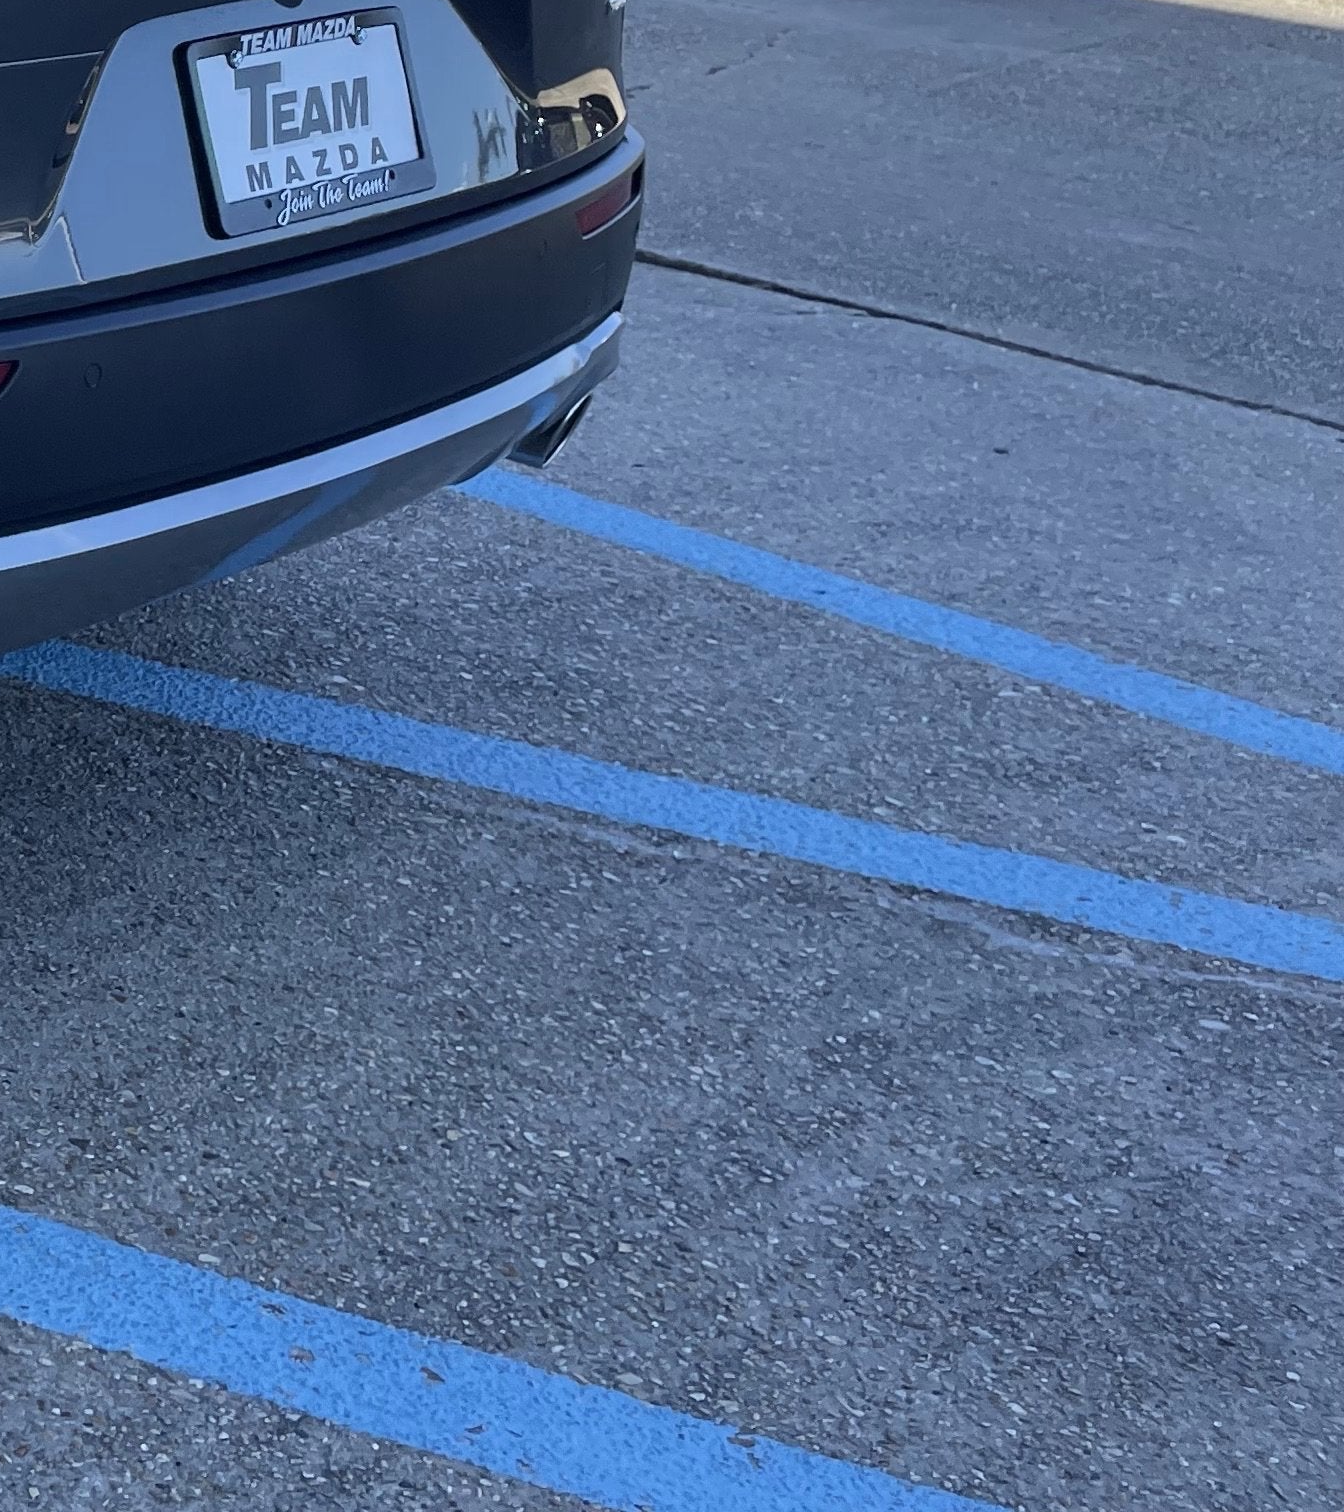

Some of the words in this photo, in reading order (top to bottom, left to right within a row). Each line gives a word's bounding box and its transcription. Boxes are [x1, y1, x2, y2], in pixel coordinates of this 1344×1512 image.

[240, 26, 293, 56] TEAM
[296, 14, 357, 50] MAZDA
[233, 60, 370, 151] TEAM
[244, 136, 390, 193] MAZDA
[276, 188, 315, 226] Join
[311, 179, 344, 209] The
[347, 168, 391, 202] Team!
